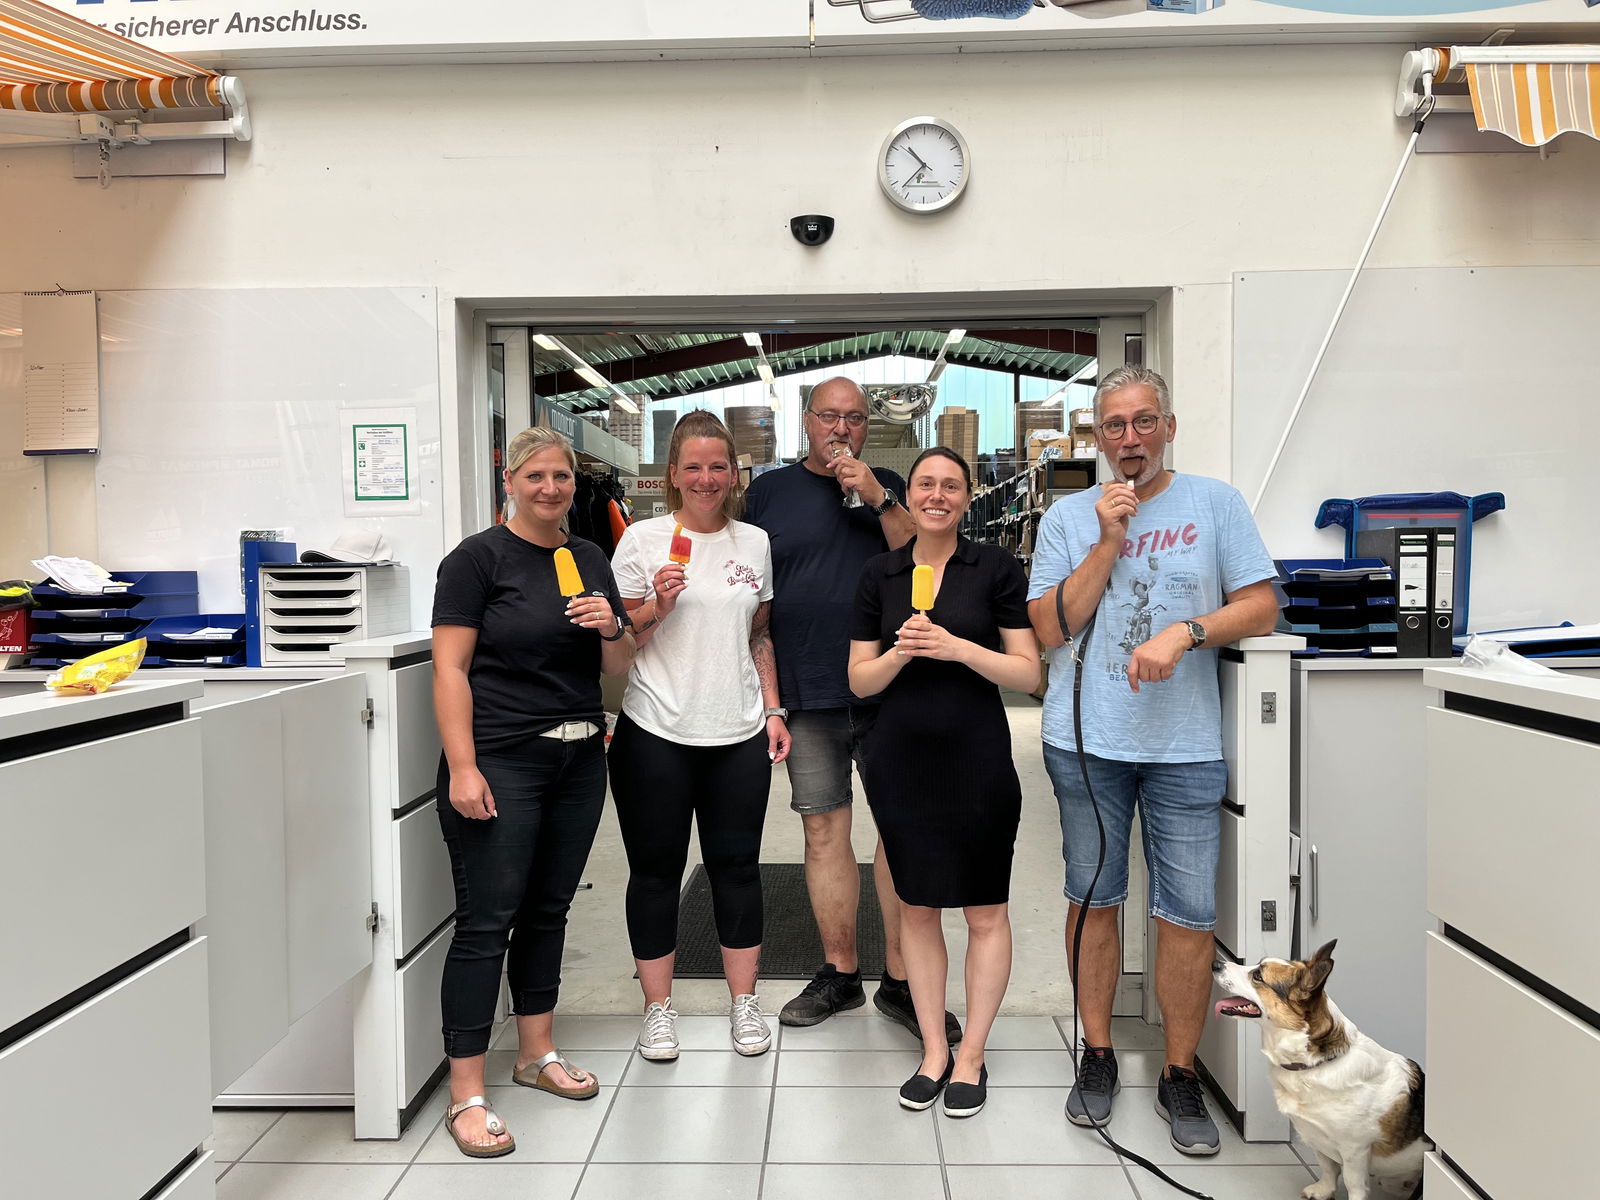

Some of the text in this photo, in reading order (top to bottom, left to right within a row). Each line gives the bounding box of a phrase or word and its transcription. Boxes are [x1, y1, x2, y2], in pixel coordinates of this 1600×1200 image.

[114, 16, 219, 38] sicherer
[225, 10, 368, 35] Anschluss.
[637, 480, 665, 489] BOSC
[1164, 583, 1198, 591] RAGMAN
